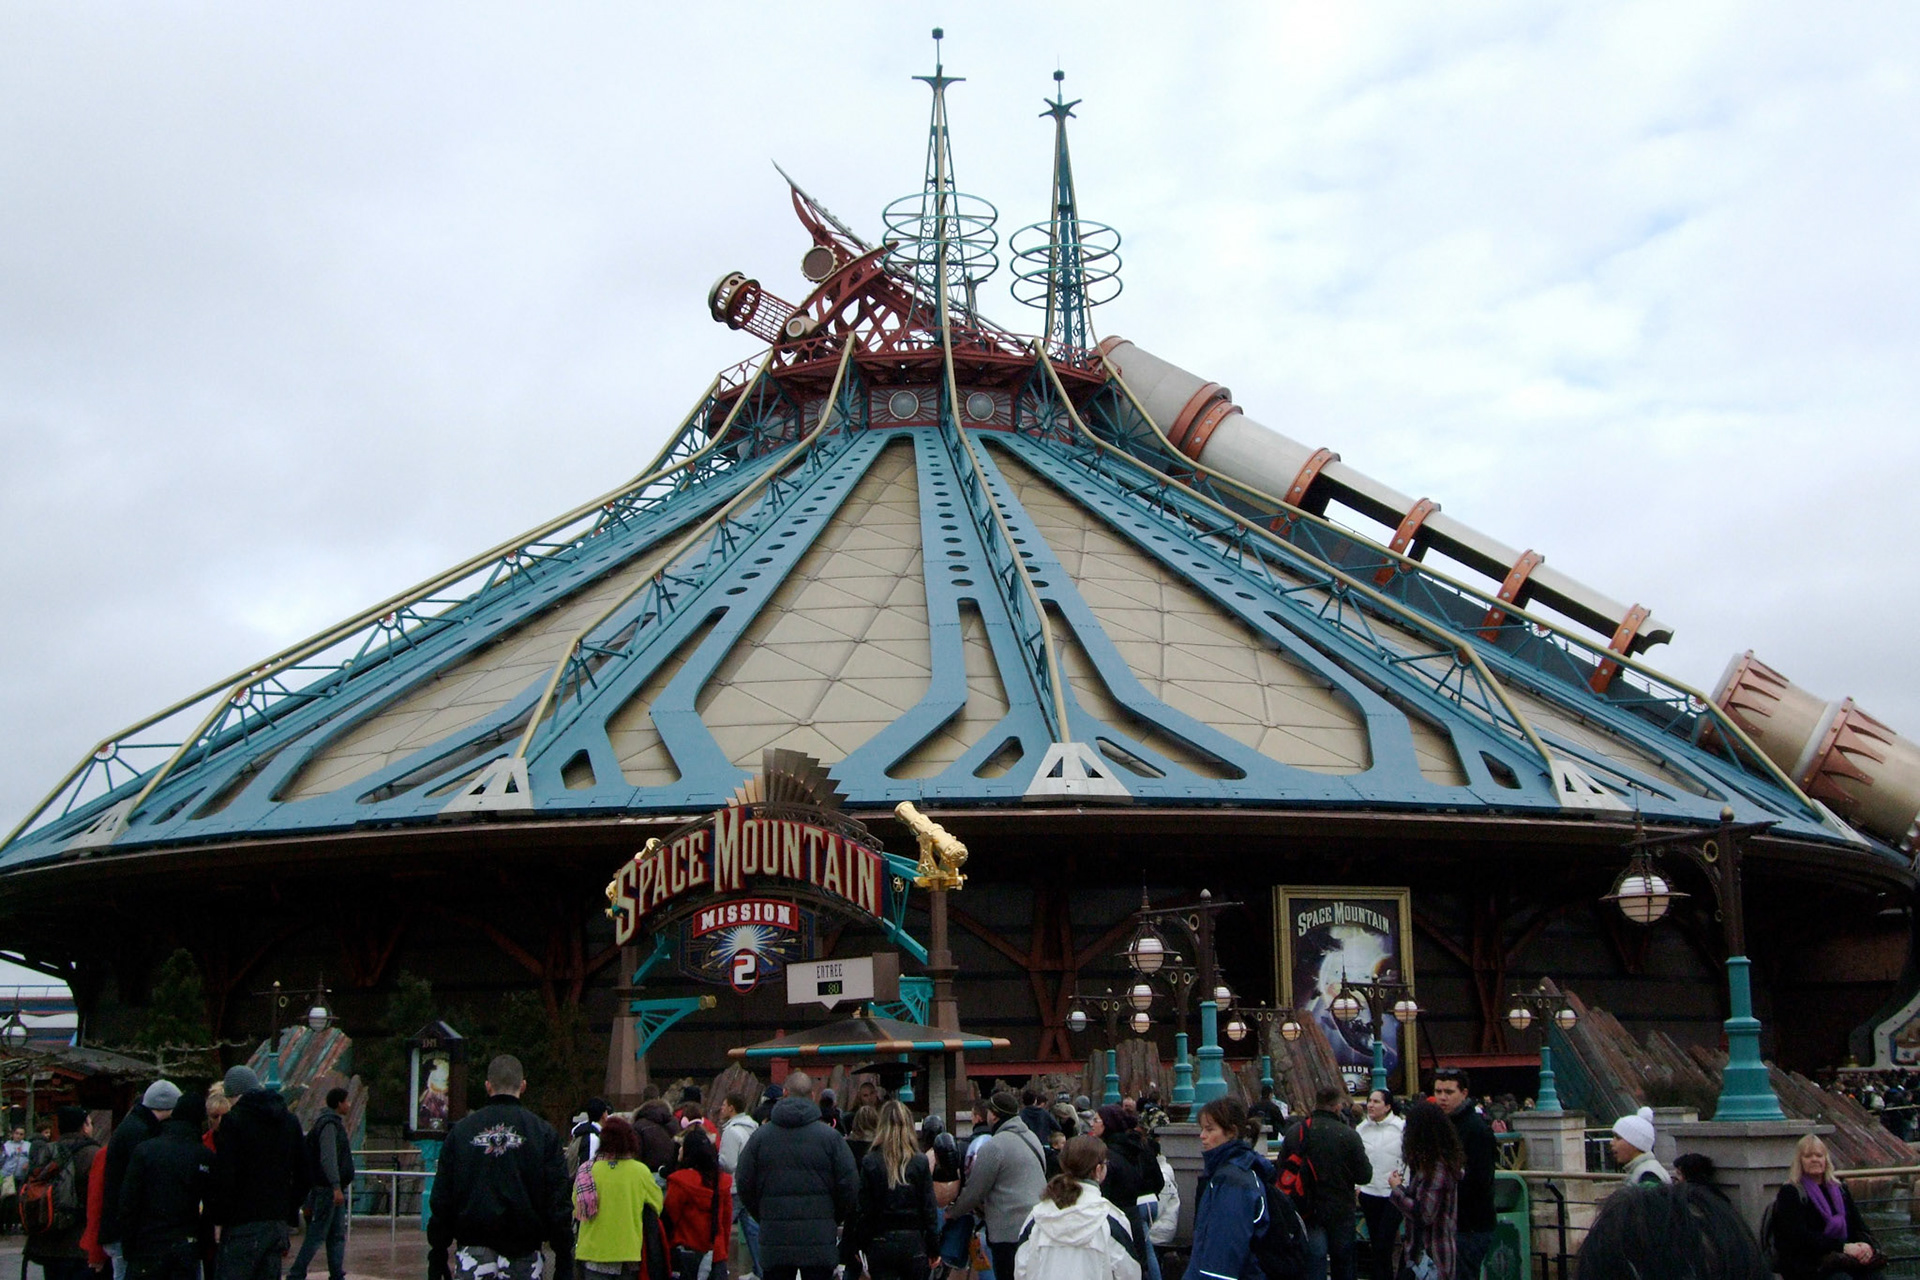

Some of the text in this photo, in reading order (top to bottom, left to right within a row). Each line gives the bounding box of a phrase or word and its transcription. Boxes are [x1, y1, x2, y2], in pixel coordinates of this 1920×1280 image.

[616, 806, 877, 946] SPACE MOUNTAIN
[701, 903, 791, 931] MISSION
[1297, 901, 1390, 937] SPACE MOUNTAIN
[733, 954, 756, 985] 2
[827, 982, 840, 995] 80
